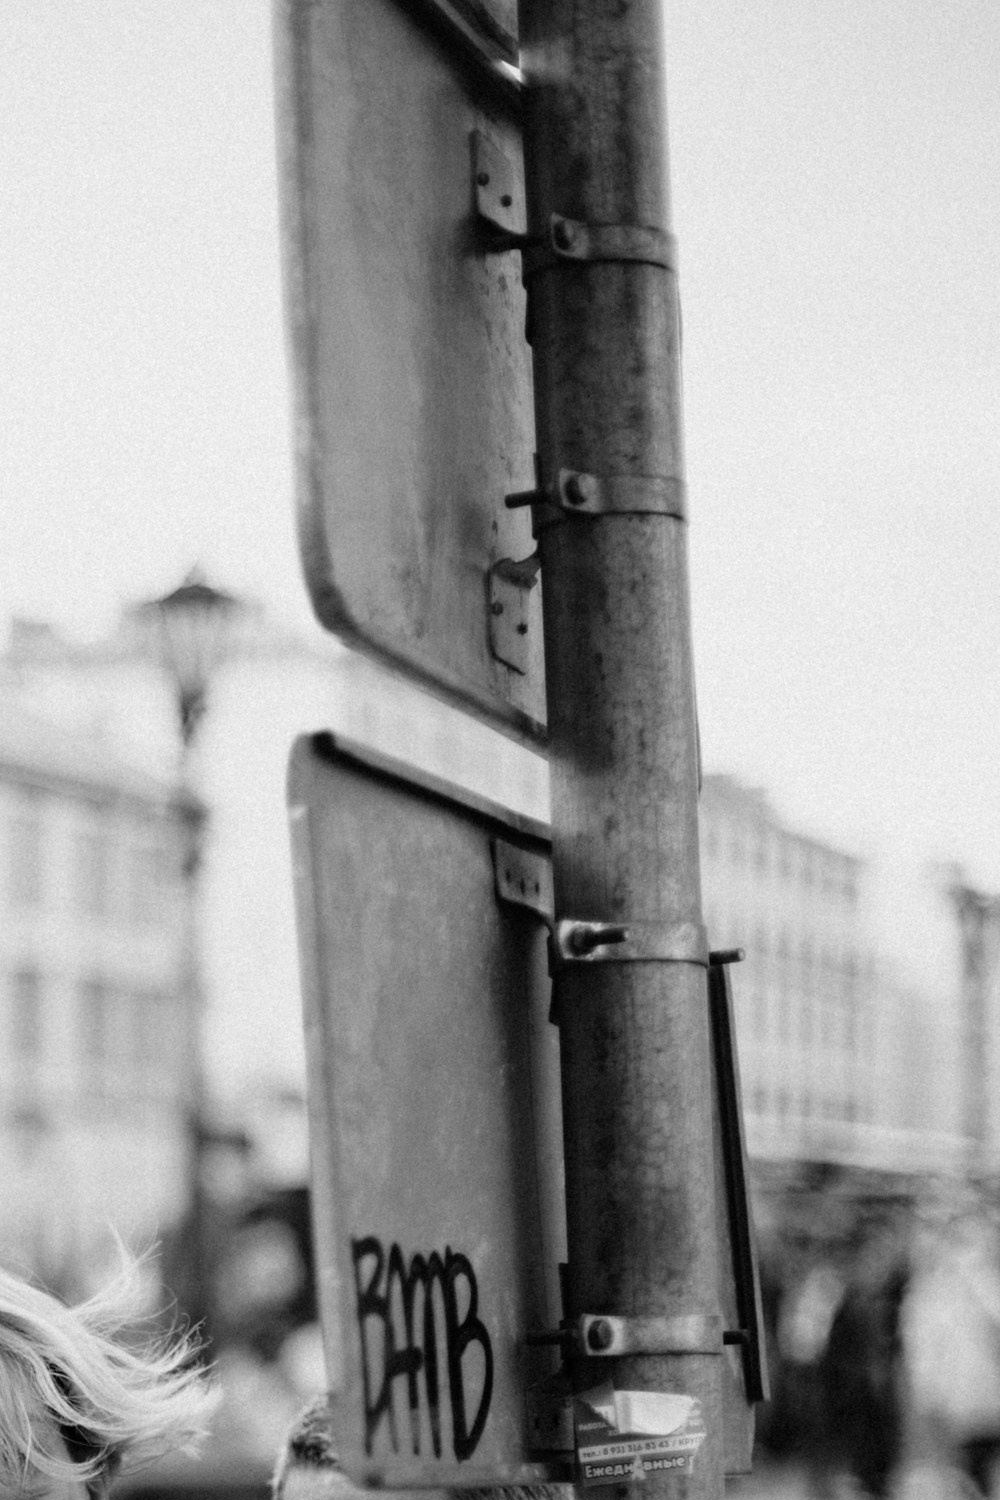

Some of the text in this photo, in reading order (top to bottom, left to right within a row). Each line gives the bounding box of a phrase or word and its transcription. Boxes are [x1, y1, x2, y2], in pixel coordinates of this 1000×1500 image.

[603, 1447, 609, 1455] 8
[610, 1445, 626, 1454] 931
[627, 1443, 643, 1452] 316
[645, 1441, 657, 1450] 83
[658, 1439, 670, 1448] 43
[584, 1456, 686, 1479] Ежеднвные
